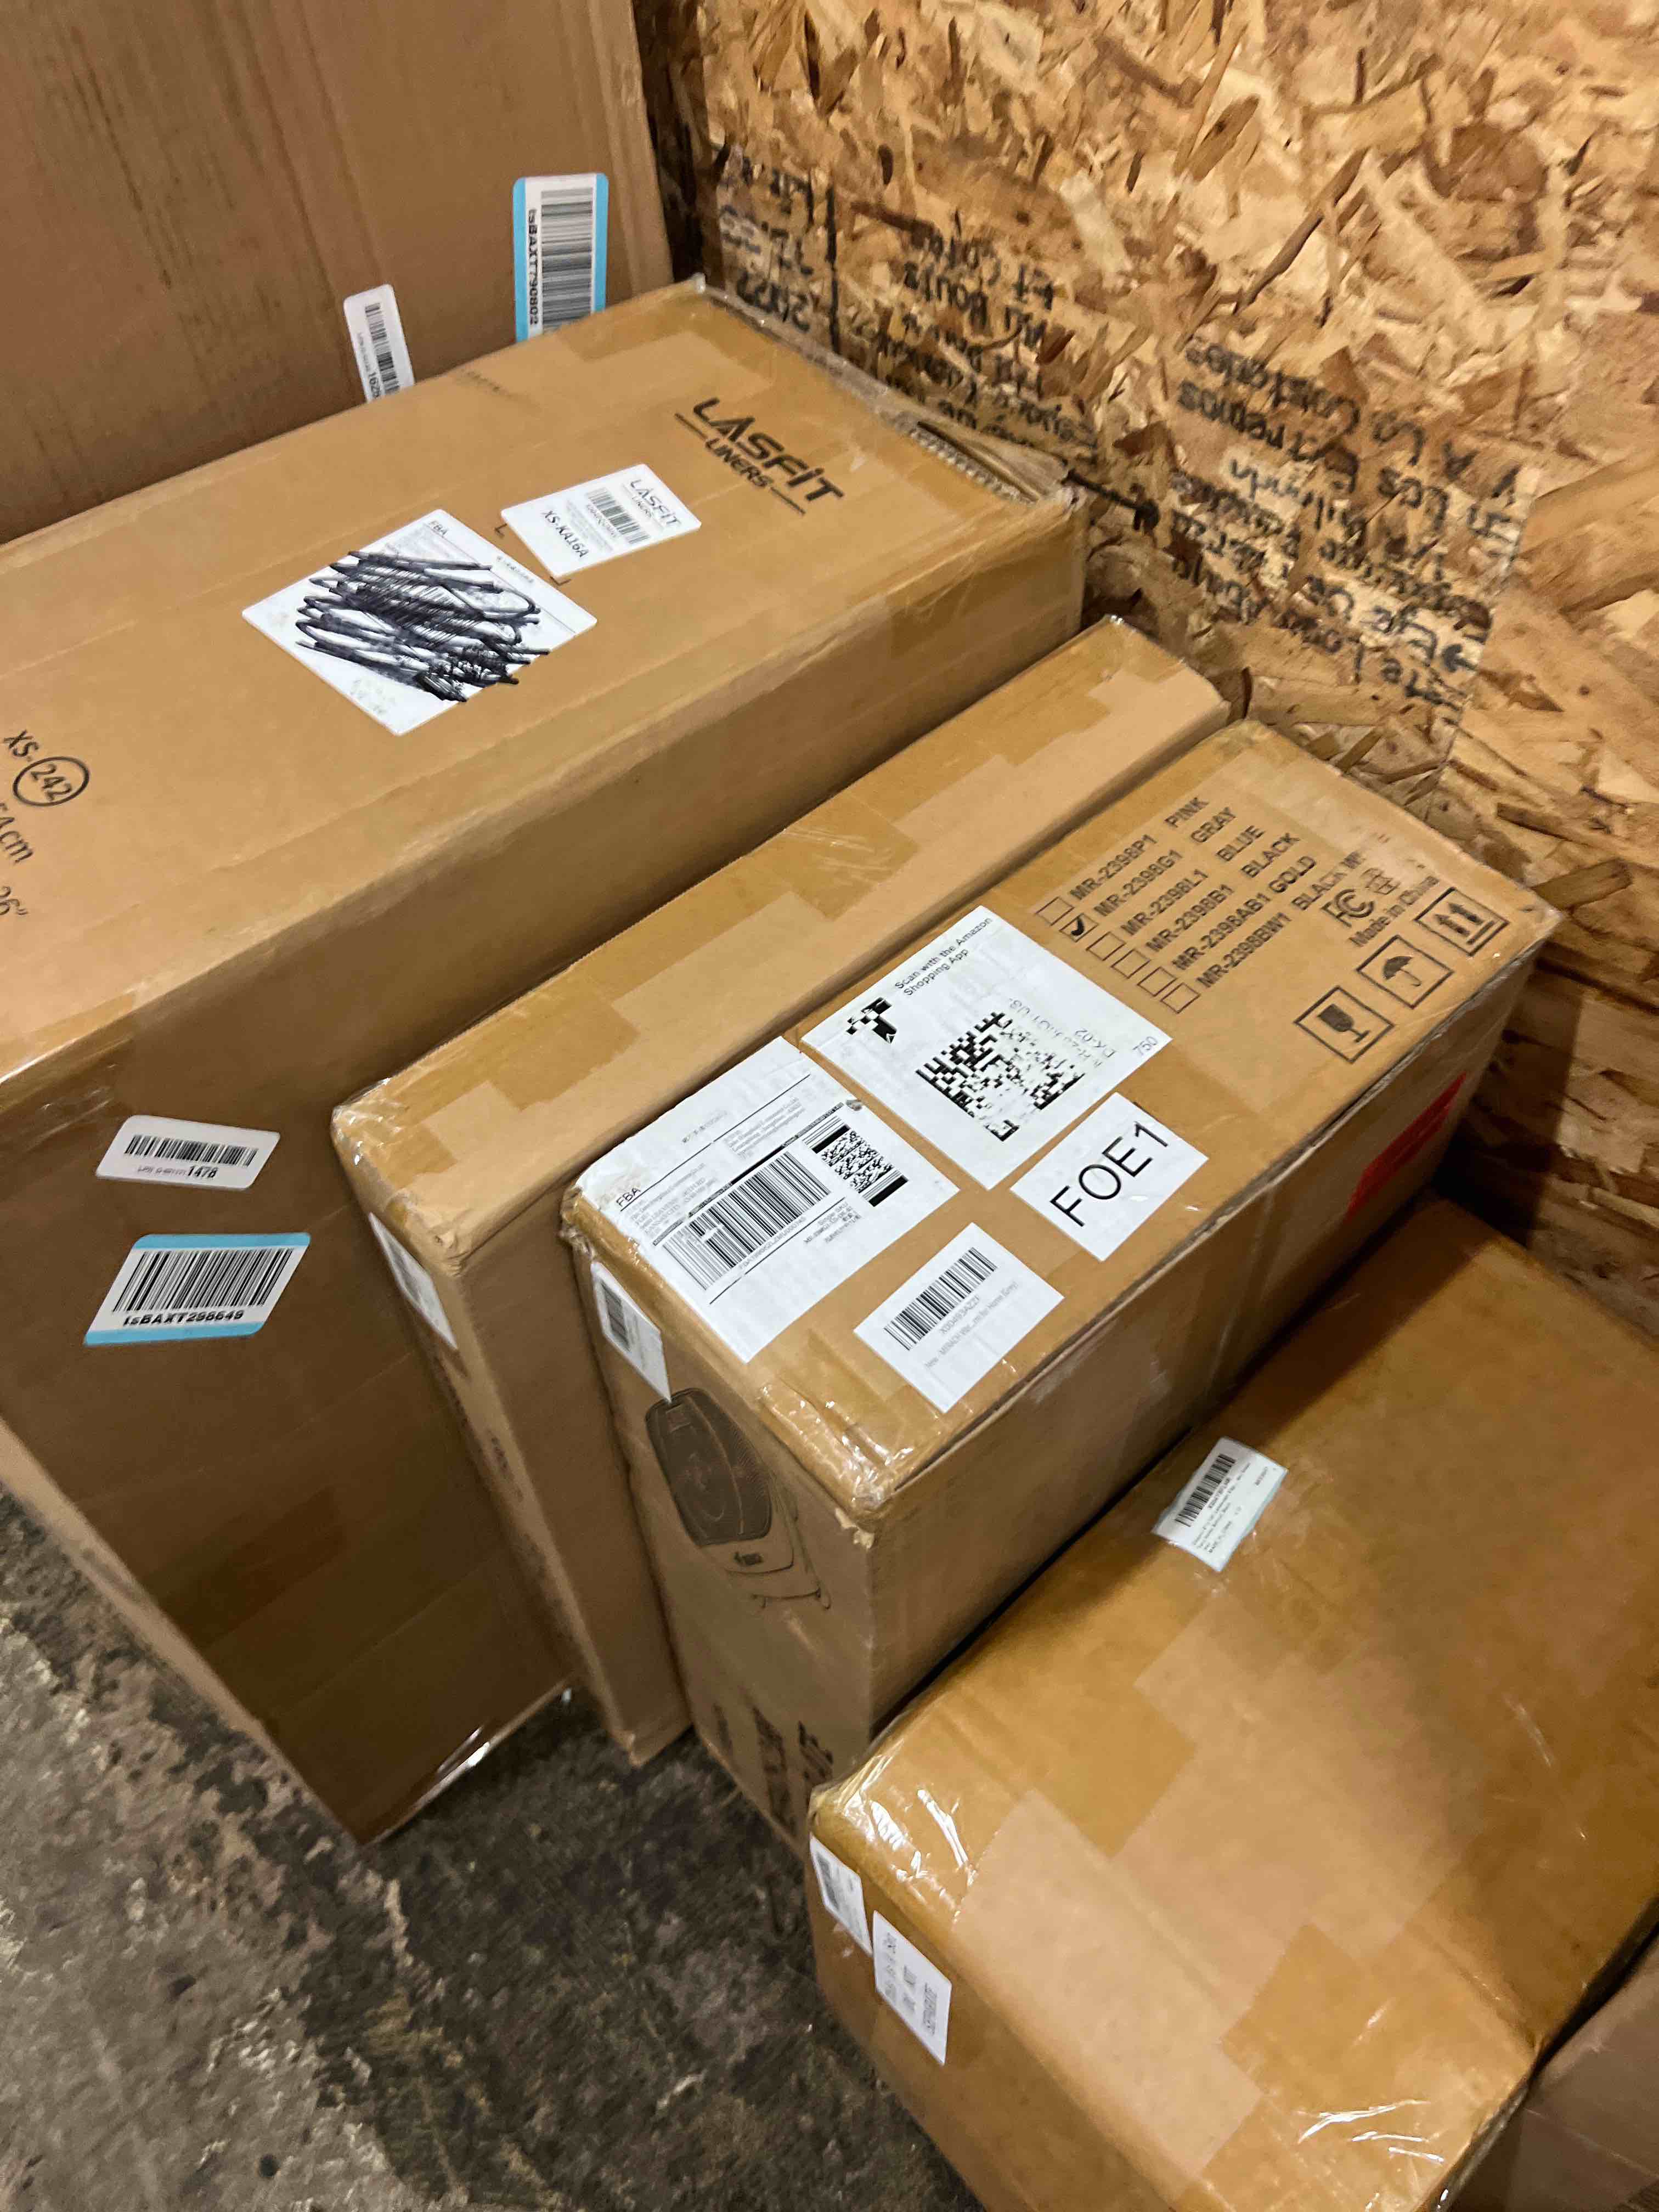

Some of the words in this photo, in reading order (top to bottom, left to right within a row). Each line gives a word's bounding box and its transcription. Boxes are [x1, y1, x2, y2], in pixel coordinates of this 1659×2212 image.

[704, 438, 774, 488] LINERS
[1070, 834, 1158, 900] MR-2398P1
[1164, 797, 1209, 828] PINK
[1093, 849, 1182, 917] MR-2398G1
[1190, 806, 1235, 844] GRAY
[1268, 855, 1317, 893] GOLD
[1120, 868, 1209, 935] MR-2398L1
[1215, 825, 1265, 862] BLUE
[1145, 883, 1235, 952] MR-2398B1
[1240, 832, 1300, 878] BLACK
[895, 970, 921, 989] Scan
[921, 956, 940, 971] with
[939, 945, 956, 957] the
[956, 917, 992, 946] Amazon
[1348, 915, 1390, 947] Made
[904, 962, 951, 996] Shopping
[949, 949, 969, 964] App
[1132, 1035, 1159, 1058] 750
[616, 1186, 641, 1207] FBA
[1049, 1120, 1169, 1227] FOE1
